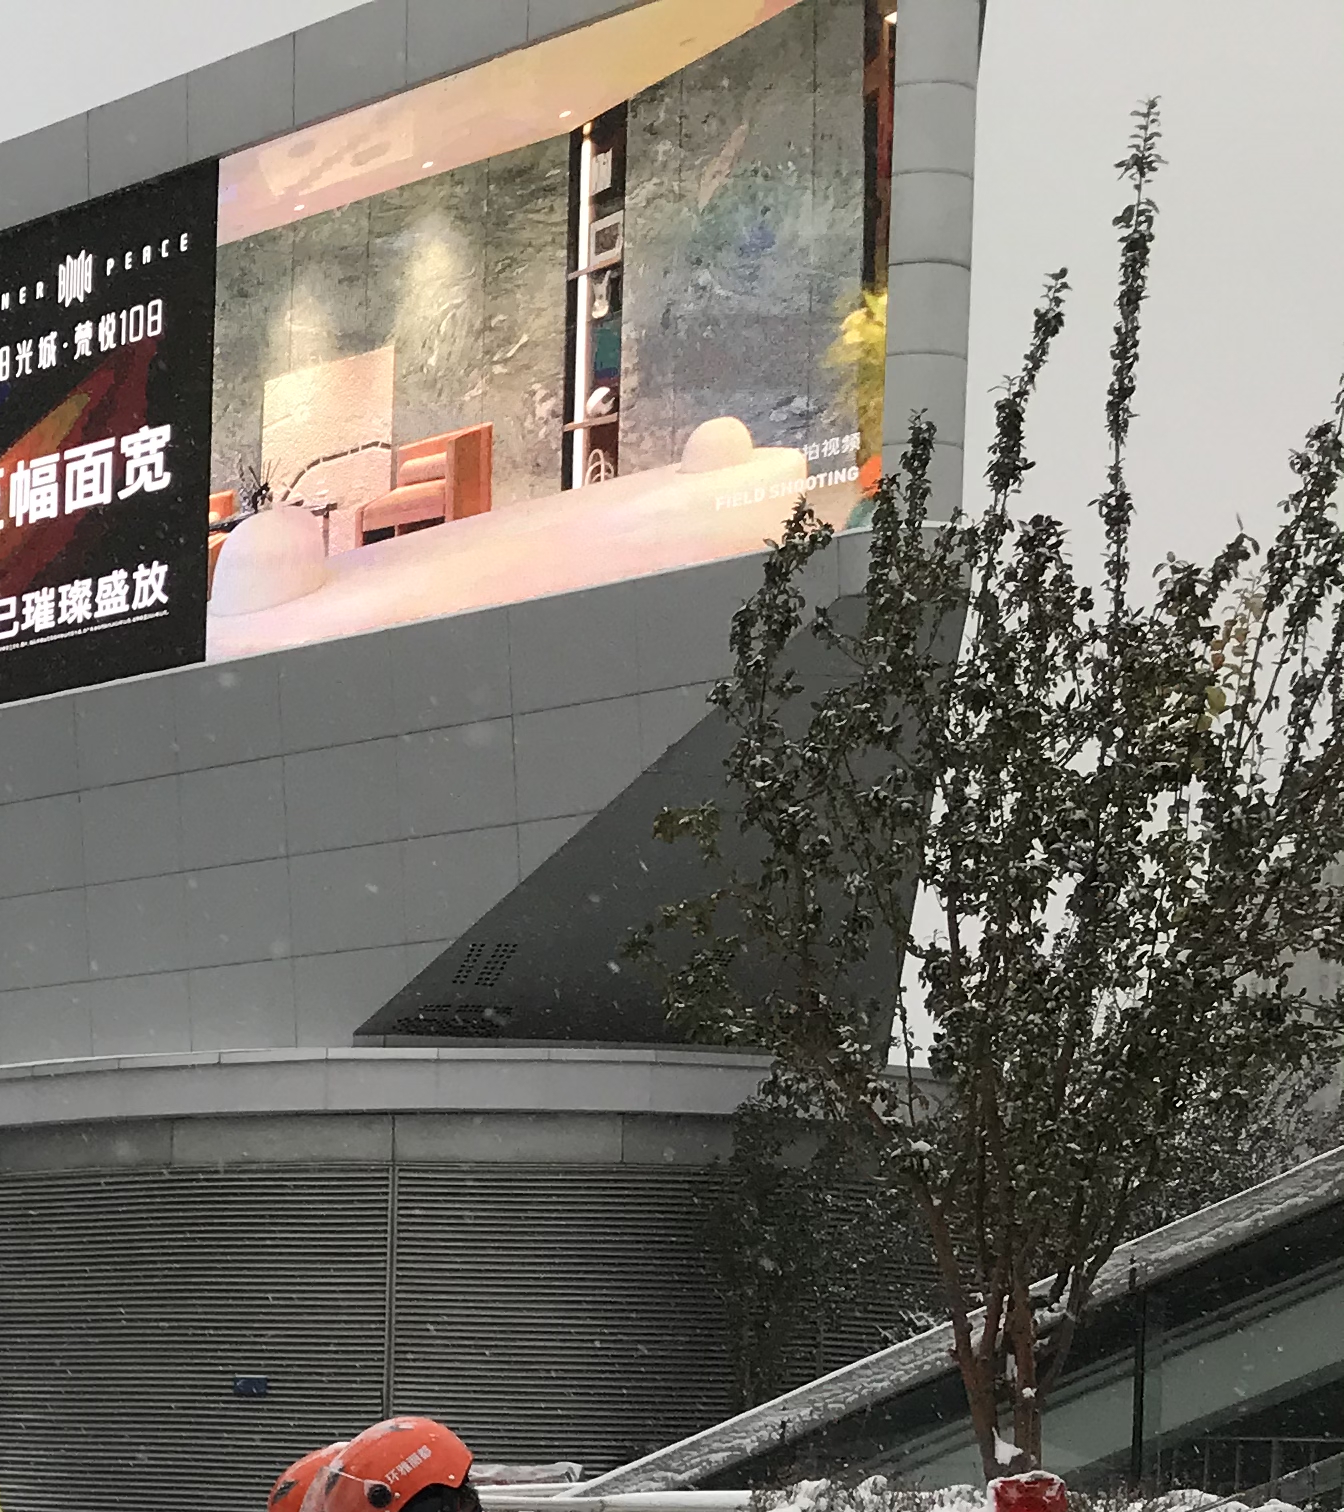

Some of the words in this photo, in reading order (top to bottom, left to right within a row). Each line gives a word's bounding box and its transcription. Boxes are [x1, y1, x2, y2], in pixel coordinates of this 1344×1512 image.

[105, 232, 189, 277] PEACE
[715, 488, 766, 511] FIELD
[769, 465, 860, 499] SHOOTING
